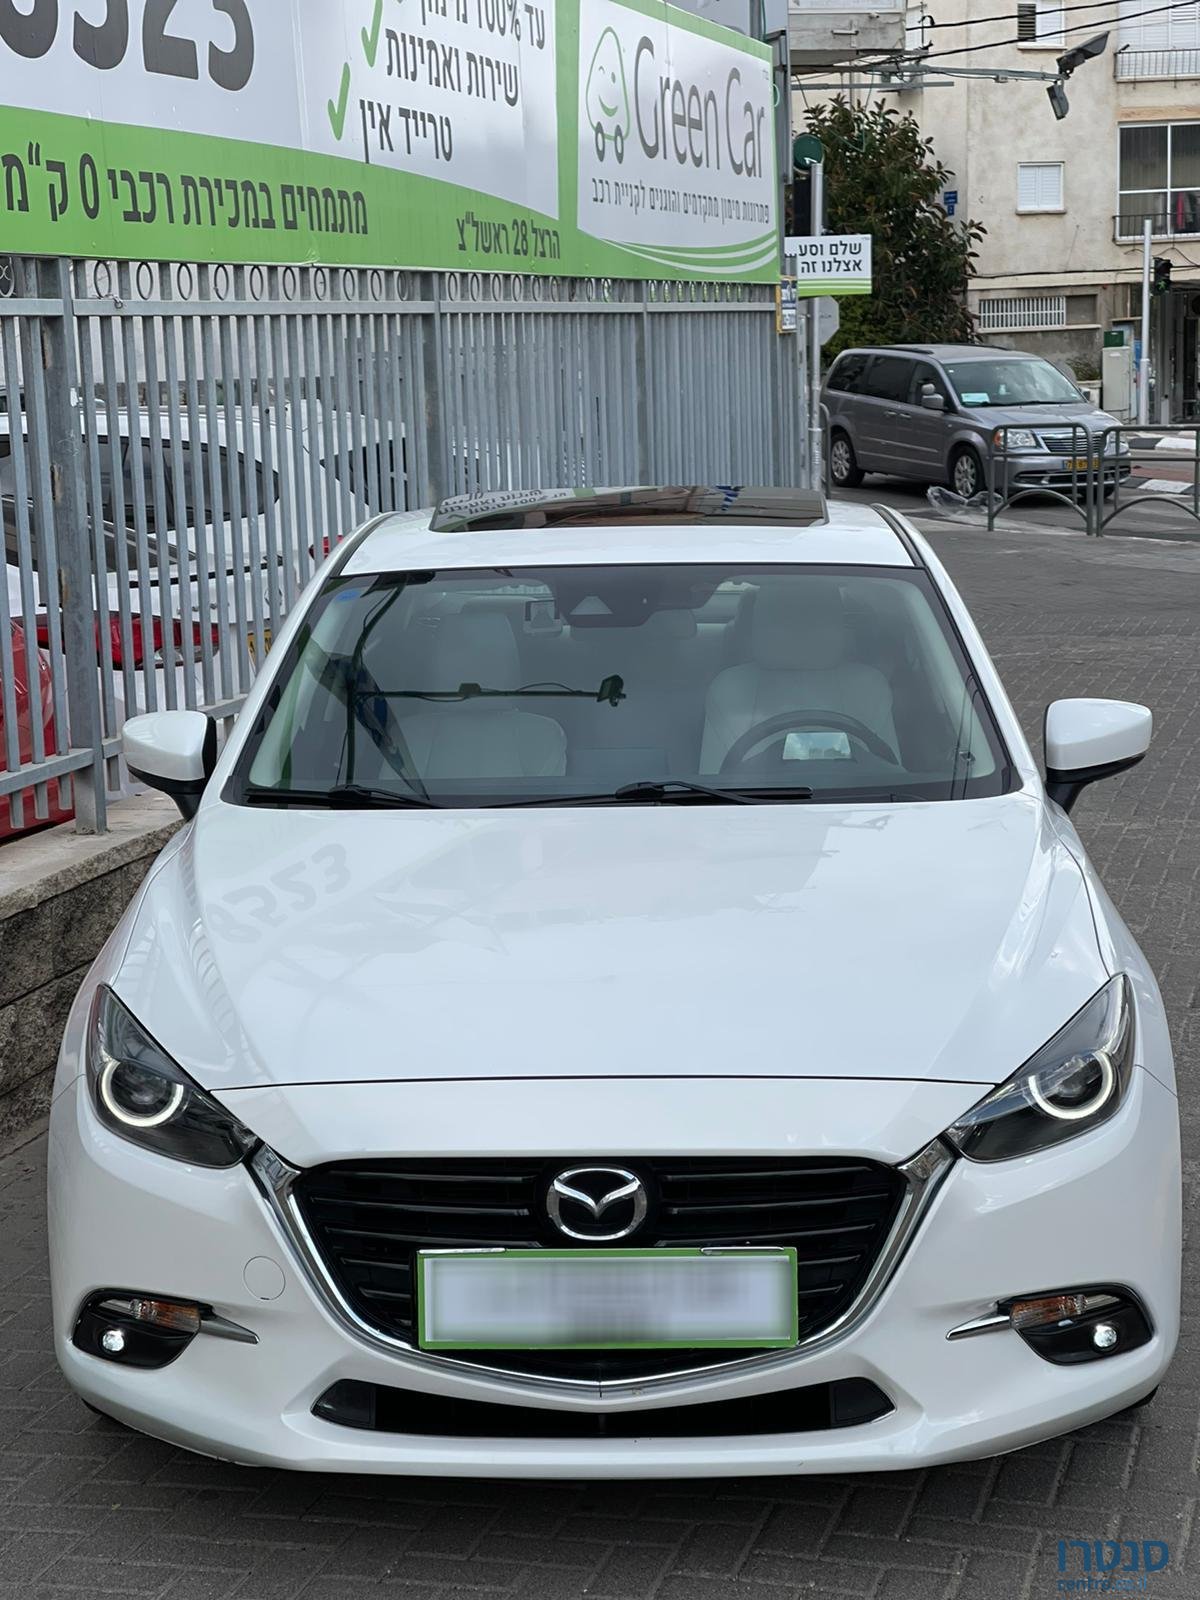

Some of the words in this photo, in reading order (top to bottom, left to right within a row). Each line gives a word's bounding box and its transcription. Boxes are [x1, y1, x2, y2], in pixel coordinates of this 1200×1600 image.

[524, 3, 545, 50] עד
[385, 28, 461, 92] ואמינות
[466, 51, 518, 107] שירות
[359, 98, 394, 164] אין
[634, 35, 720, 170] Green
[725, 67, 765, 178] Car
[398, 106, 453, 162] טרייד
[79, 152, 100, 220] 0
[107, 168, 174, 224] רכבי
[180, 174, 276, 230] במכירת
[280, 183, 369, 235] מתמחים
[591, 177, 611, 204] רכב
[614, 179, 646, 215] לקניית
[512, 218, 529, 256] 28
[531, 219, 561, 260] הרצל
[829, 240, 862, 256] שלם
[801, 261, 818, 273] זה
[822, 257, 862, 273] אצלנו
